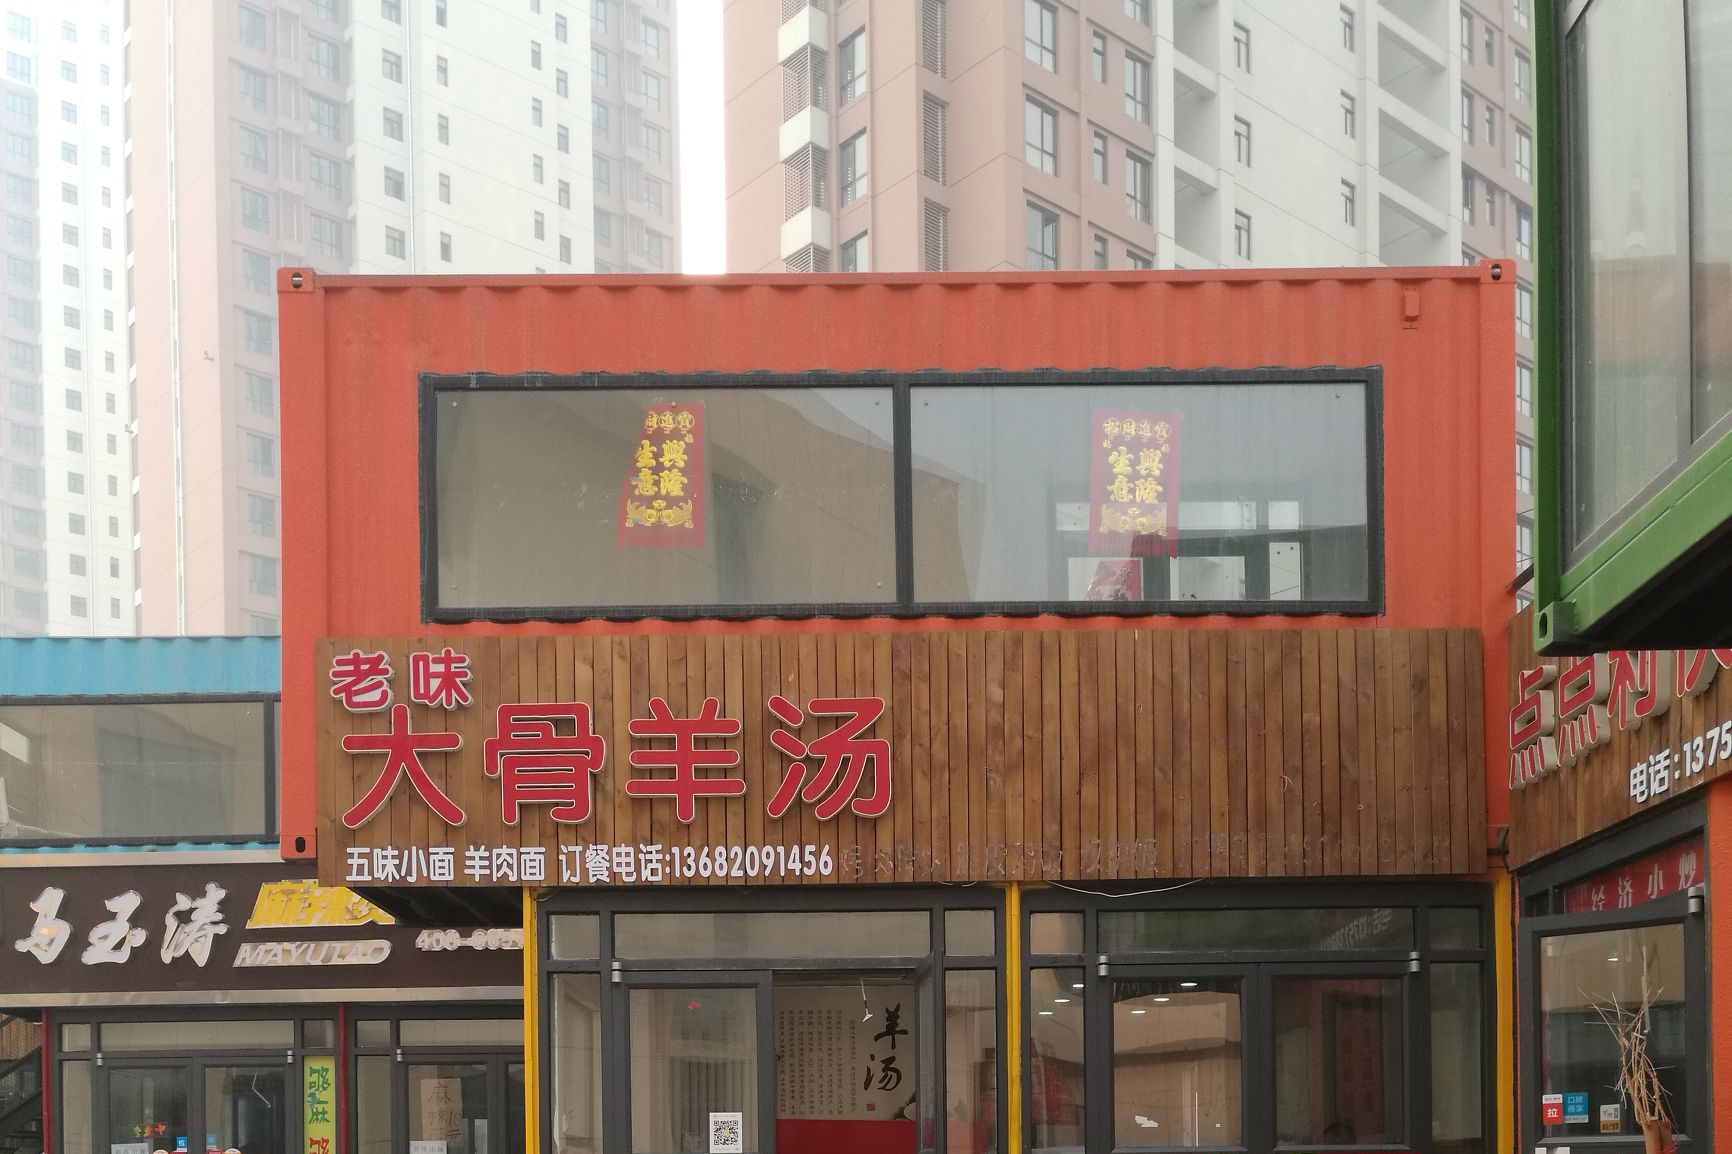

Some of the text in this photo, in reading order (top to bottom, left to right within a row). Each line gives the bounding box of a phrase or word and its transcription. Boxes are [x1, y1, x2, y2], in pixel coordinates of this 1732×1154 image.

[330, 647, 473, 712] 老味
[1508, 648, 1732, 791] 点点利
[341, 696, 893, 829] 大骨羊汤
[346, 846, 455, 883] 五味小面
[464, 845, 545, 882] 羊肉面
[558, 844, 833, 882] 订餐电话:13682091456
[236, 941, 390, 967] MAYUTAO
[864, 1002, 909, 1092] 羊汤
[1547, 1108, 1558, 1118] 拉
